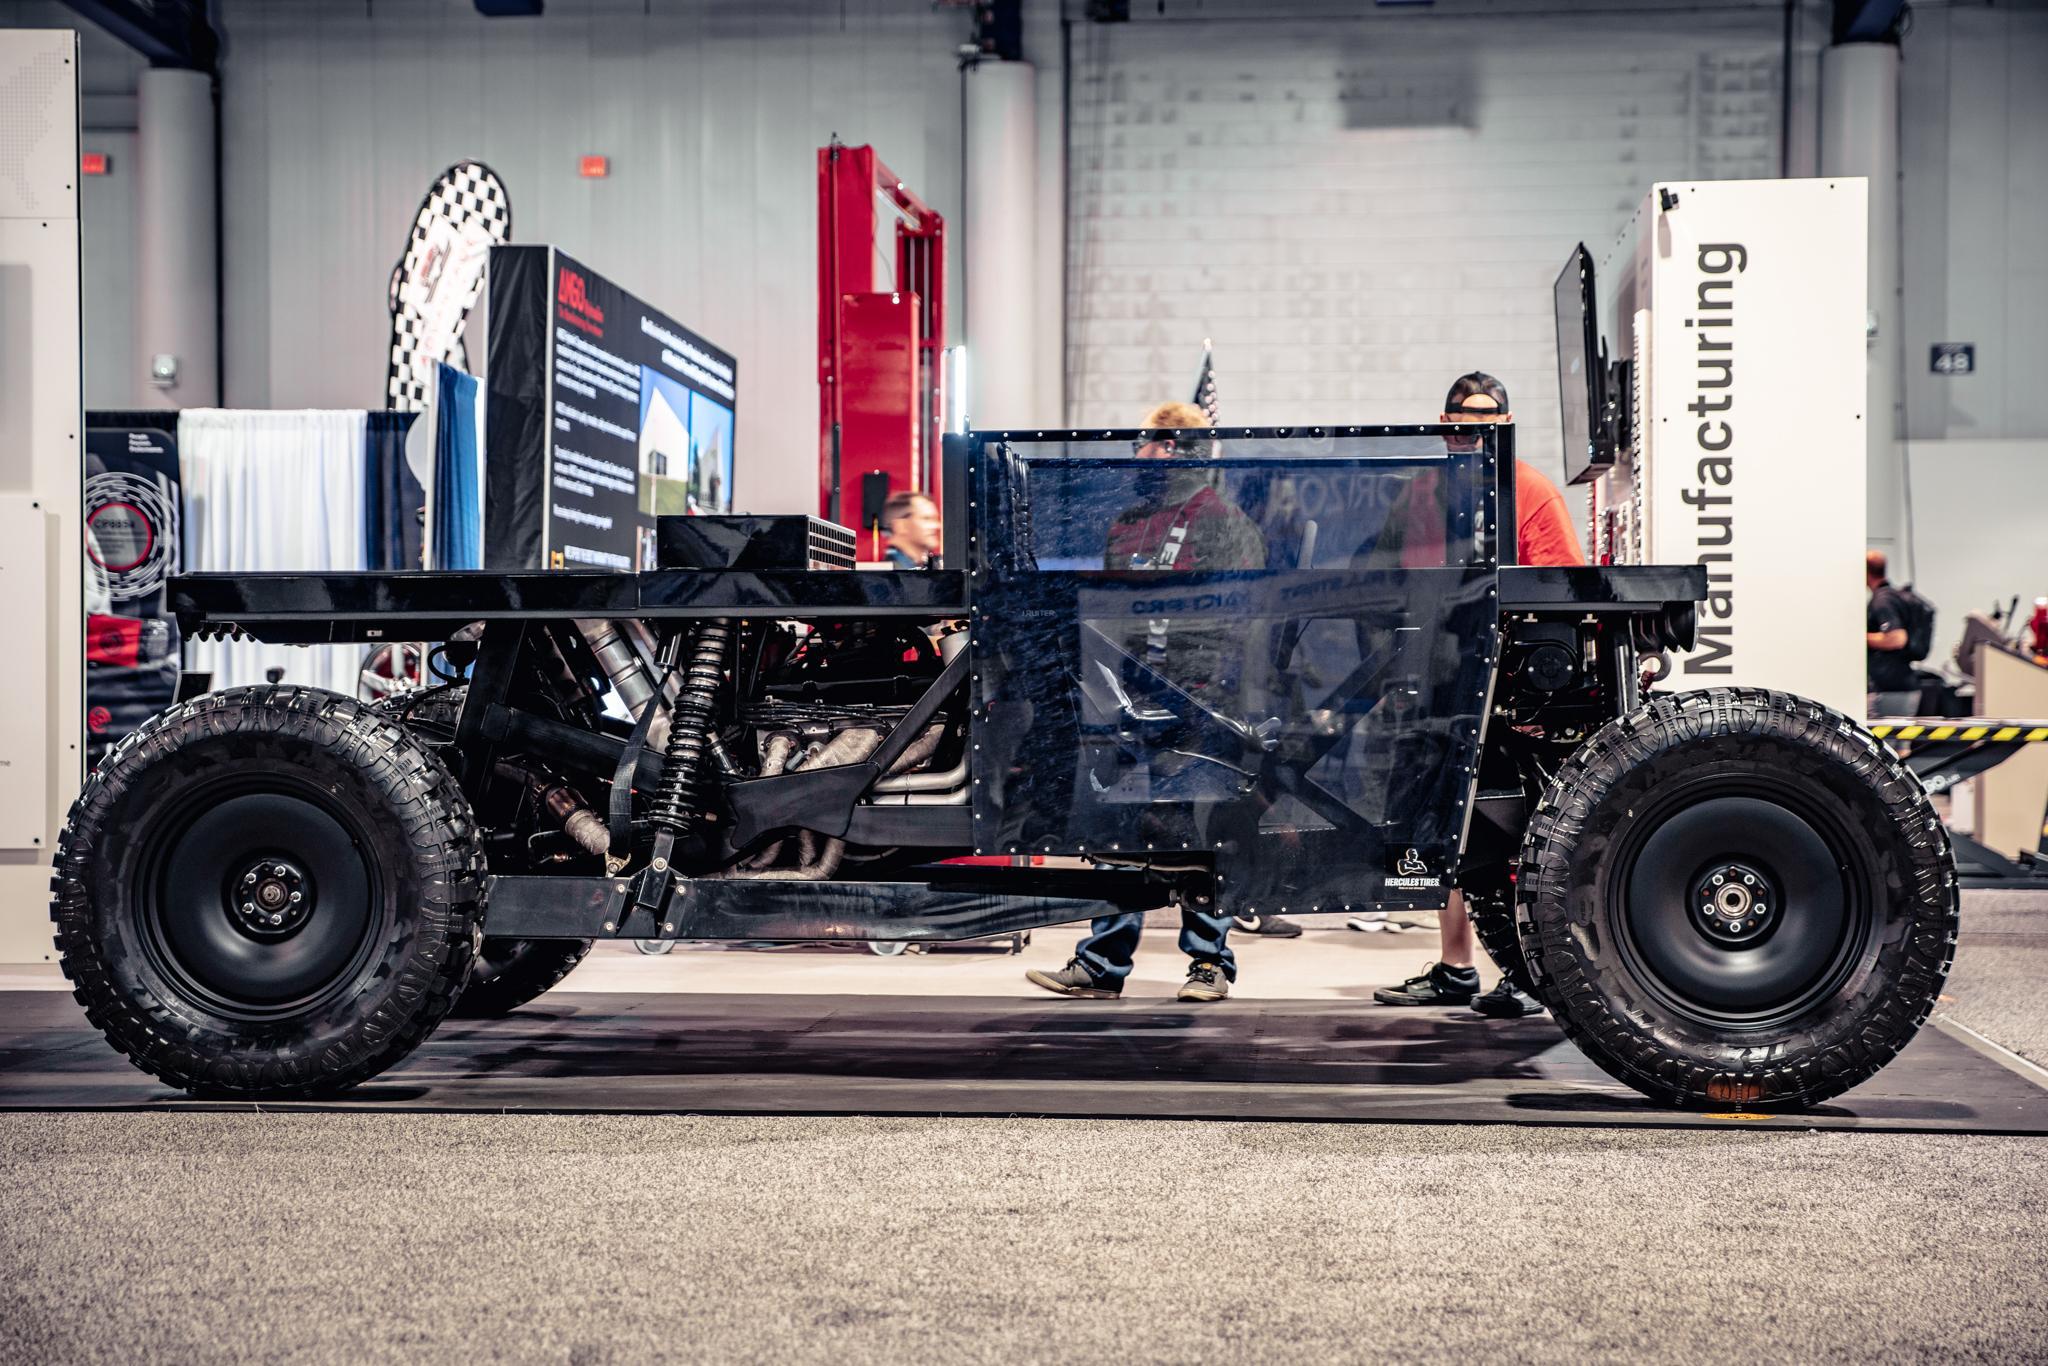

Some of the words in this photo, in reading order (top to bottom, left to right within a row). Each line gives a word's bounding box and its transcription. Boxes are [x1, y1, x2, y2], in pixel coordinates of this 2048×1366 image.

[1934, 352, 1969, 374] 48
[1682, 242, 1748, 675] Manufacturing
[1384, 877, 1420, 887] HERCULES
